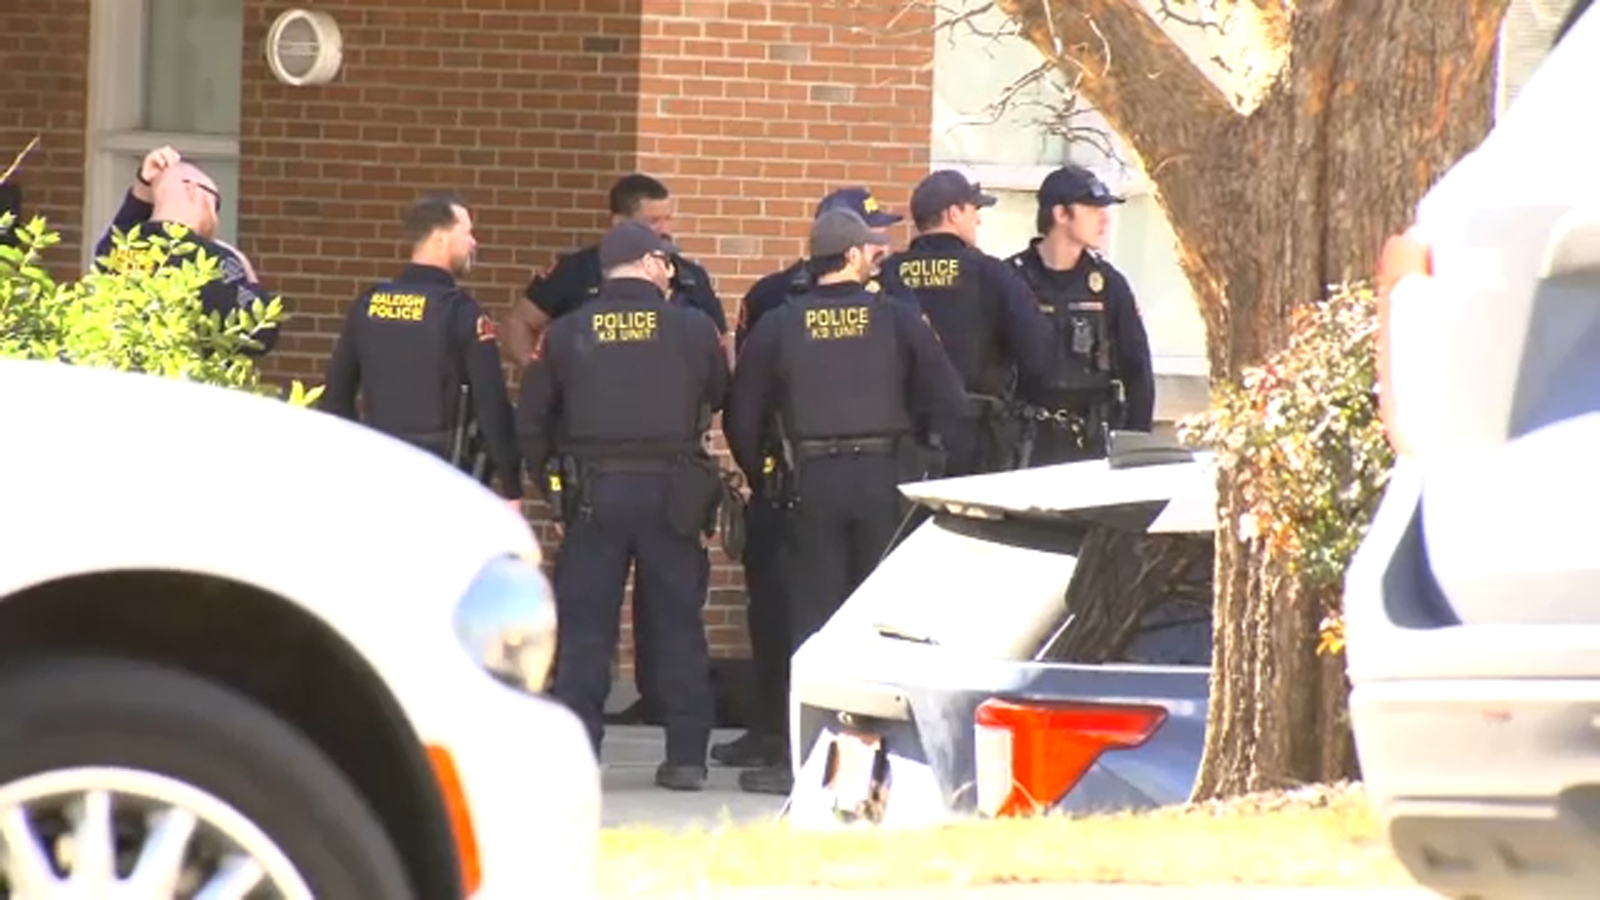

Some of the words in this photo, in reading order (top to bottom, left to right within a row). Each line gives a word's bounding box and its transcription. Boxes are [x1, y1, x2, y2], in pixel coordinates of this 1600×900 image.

[899, 259, 959, 277] POLICE
[924, 275, 953, 286] UNIT
[367, 304, 423, 321] POLICE
[593, 311, 657, 330] POLICE
[805, 306, 869, 328] POLICE
[620, 328, 651, 341] UNIT
[833, 324, 865, 338] UNIT
